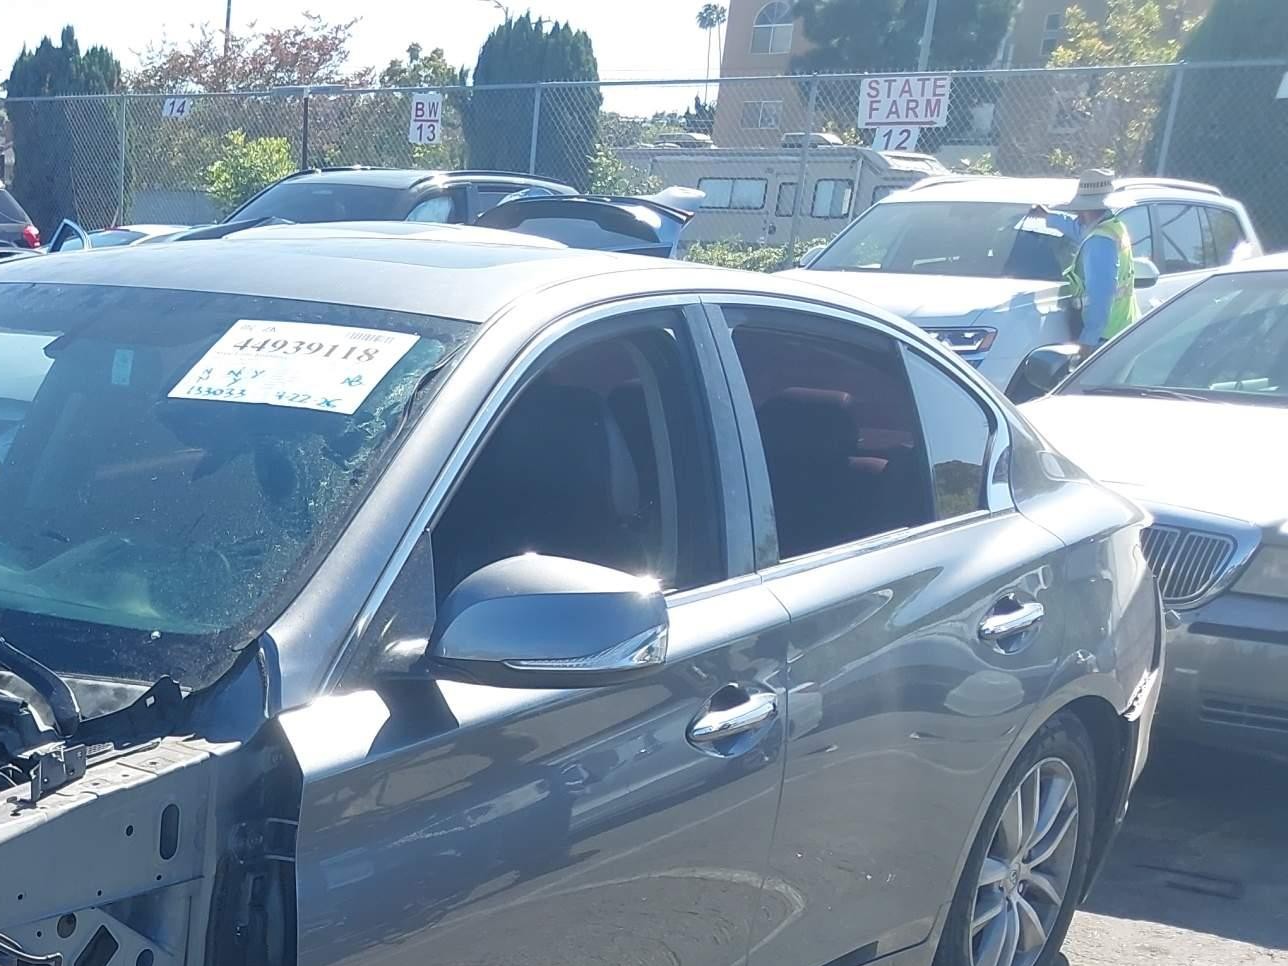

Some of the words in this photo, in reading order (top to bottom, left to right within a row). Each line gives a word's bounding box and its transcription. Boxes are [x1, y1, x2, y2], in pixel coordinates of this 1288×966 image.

[866, 77, 948, 98] STATE
[169, 99, 187, 116] 14
[415, 101, 439, 118] BW
[868, 98, 942, 120] FARM
[416, 123, 436, 142] 13
[882, 128, 912, 151] 12
[233, 337, 379, 362] 44939118
